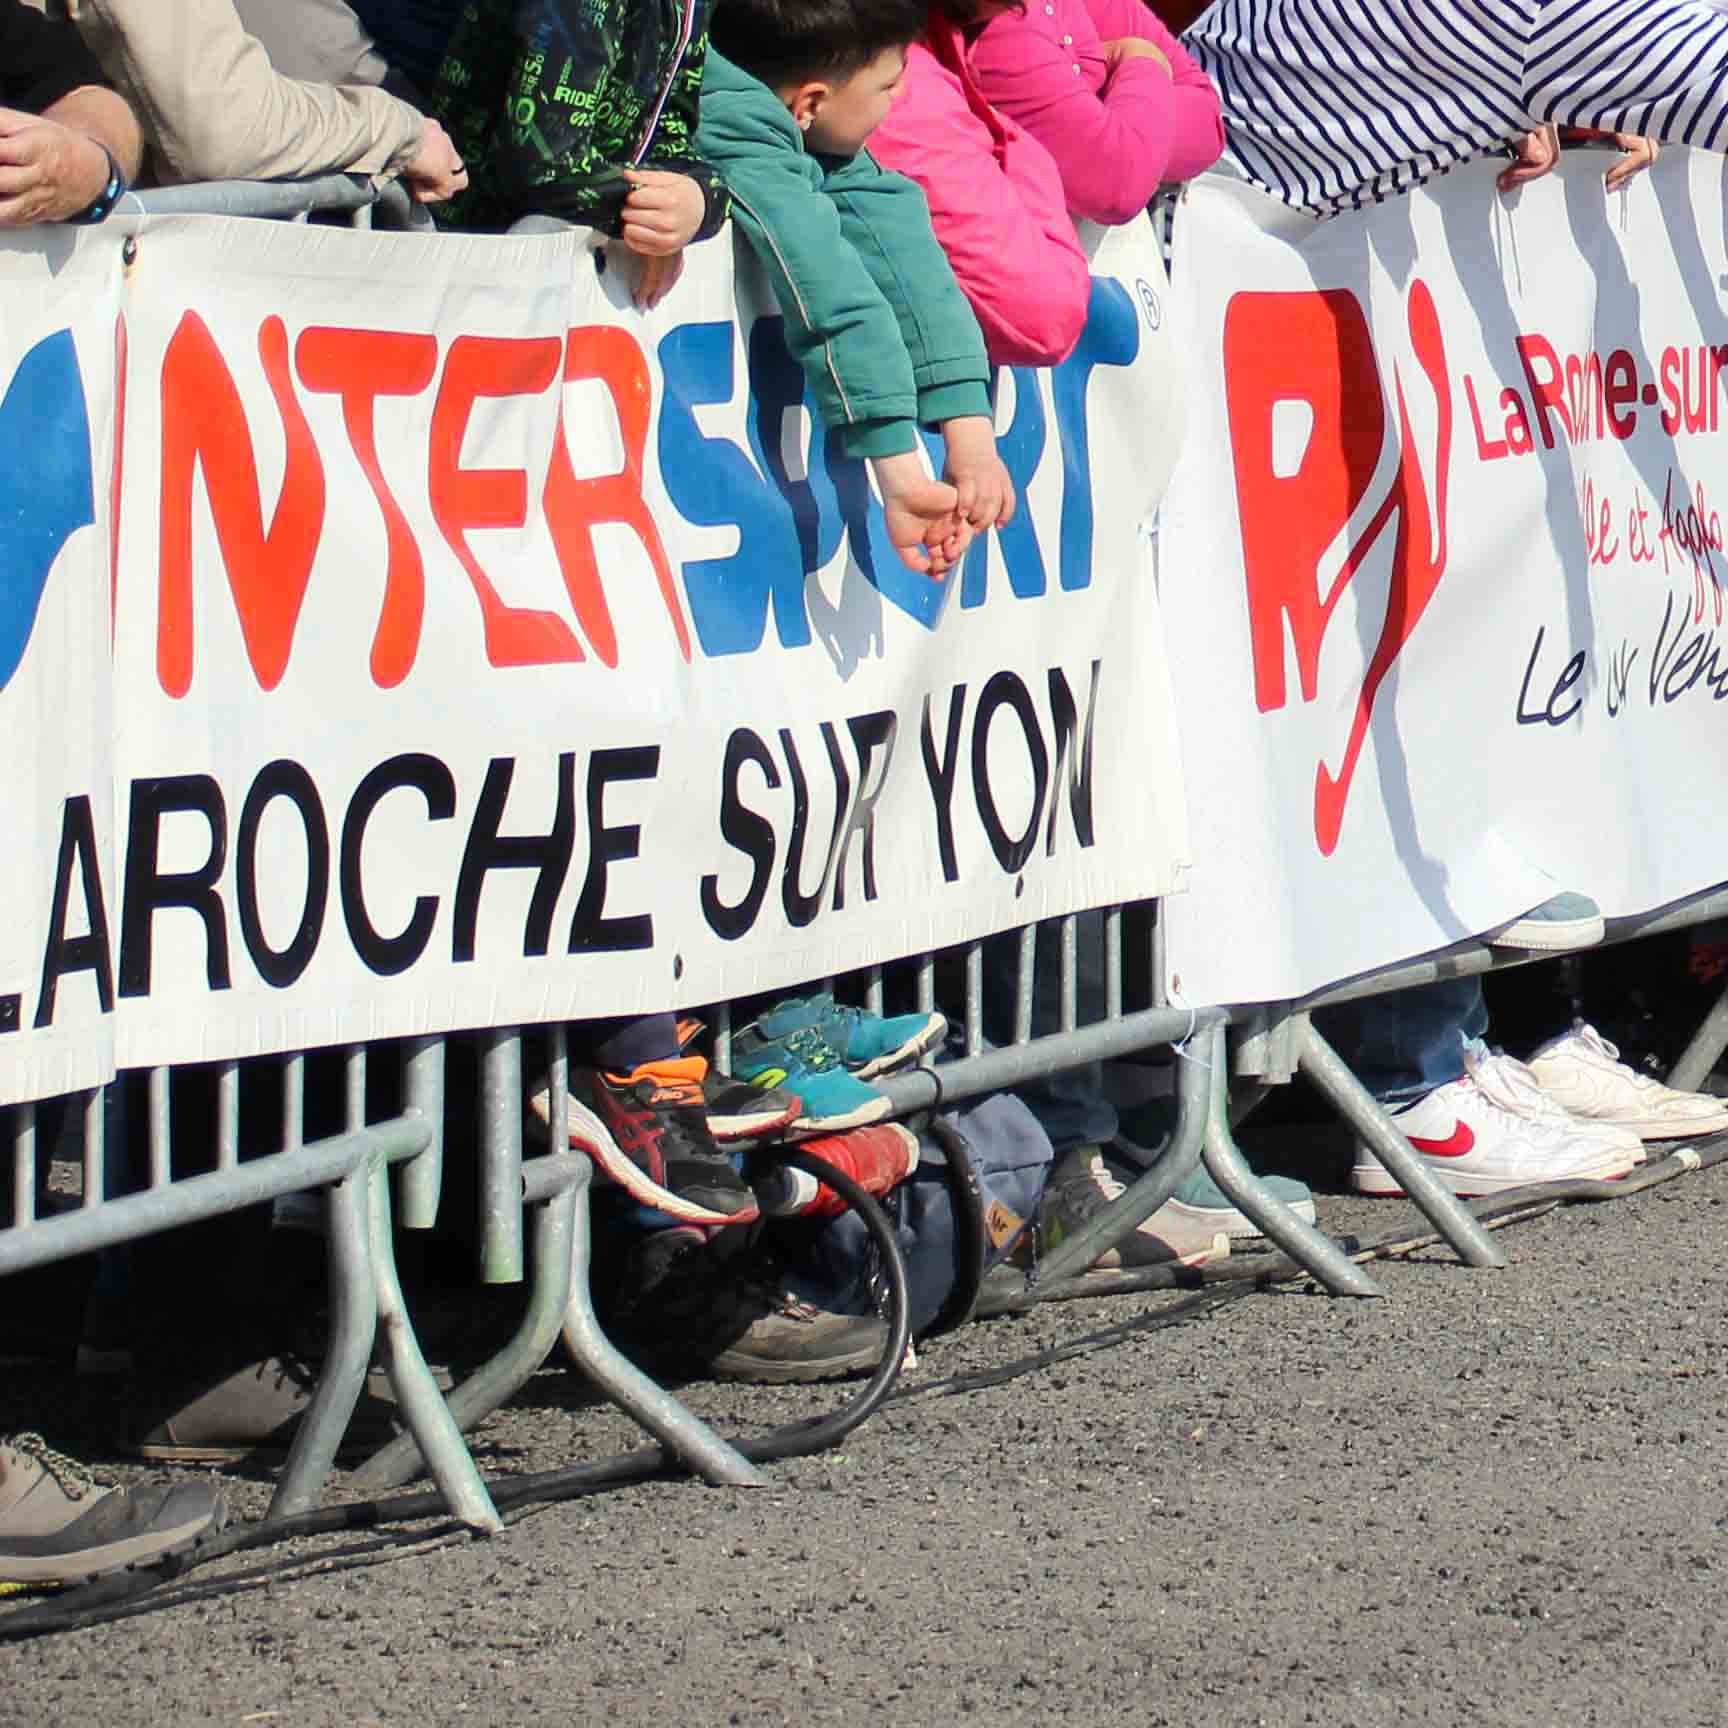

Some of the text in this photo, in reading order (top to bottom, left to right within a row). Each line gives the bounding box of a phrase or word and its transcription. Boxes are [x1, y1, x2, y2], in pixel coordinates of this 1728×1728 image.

[1629, 487, 1655, 562] et
[1515, 625, 1587, 726] Le
[697, 707, 898, 942] SUR
[918, 659, 1102, 883] YON
